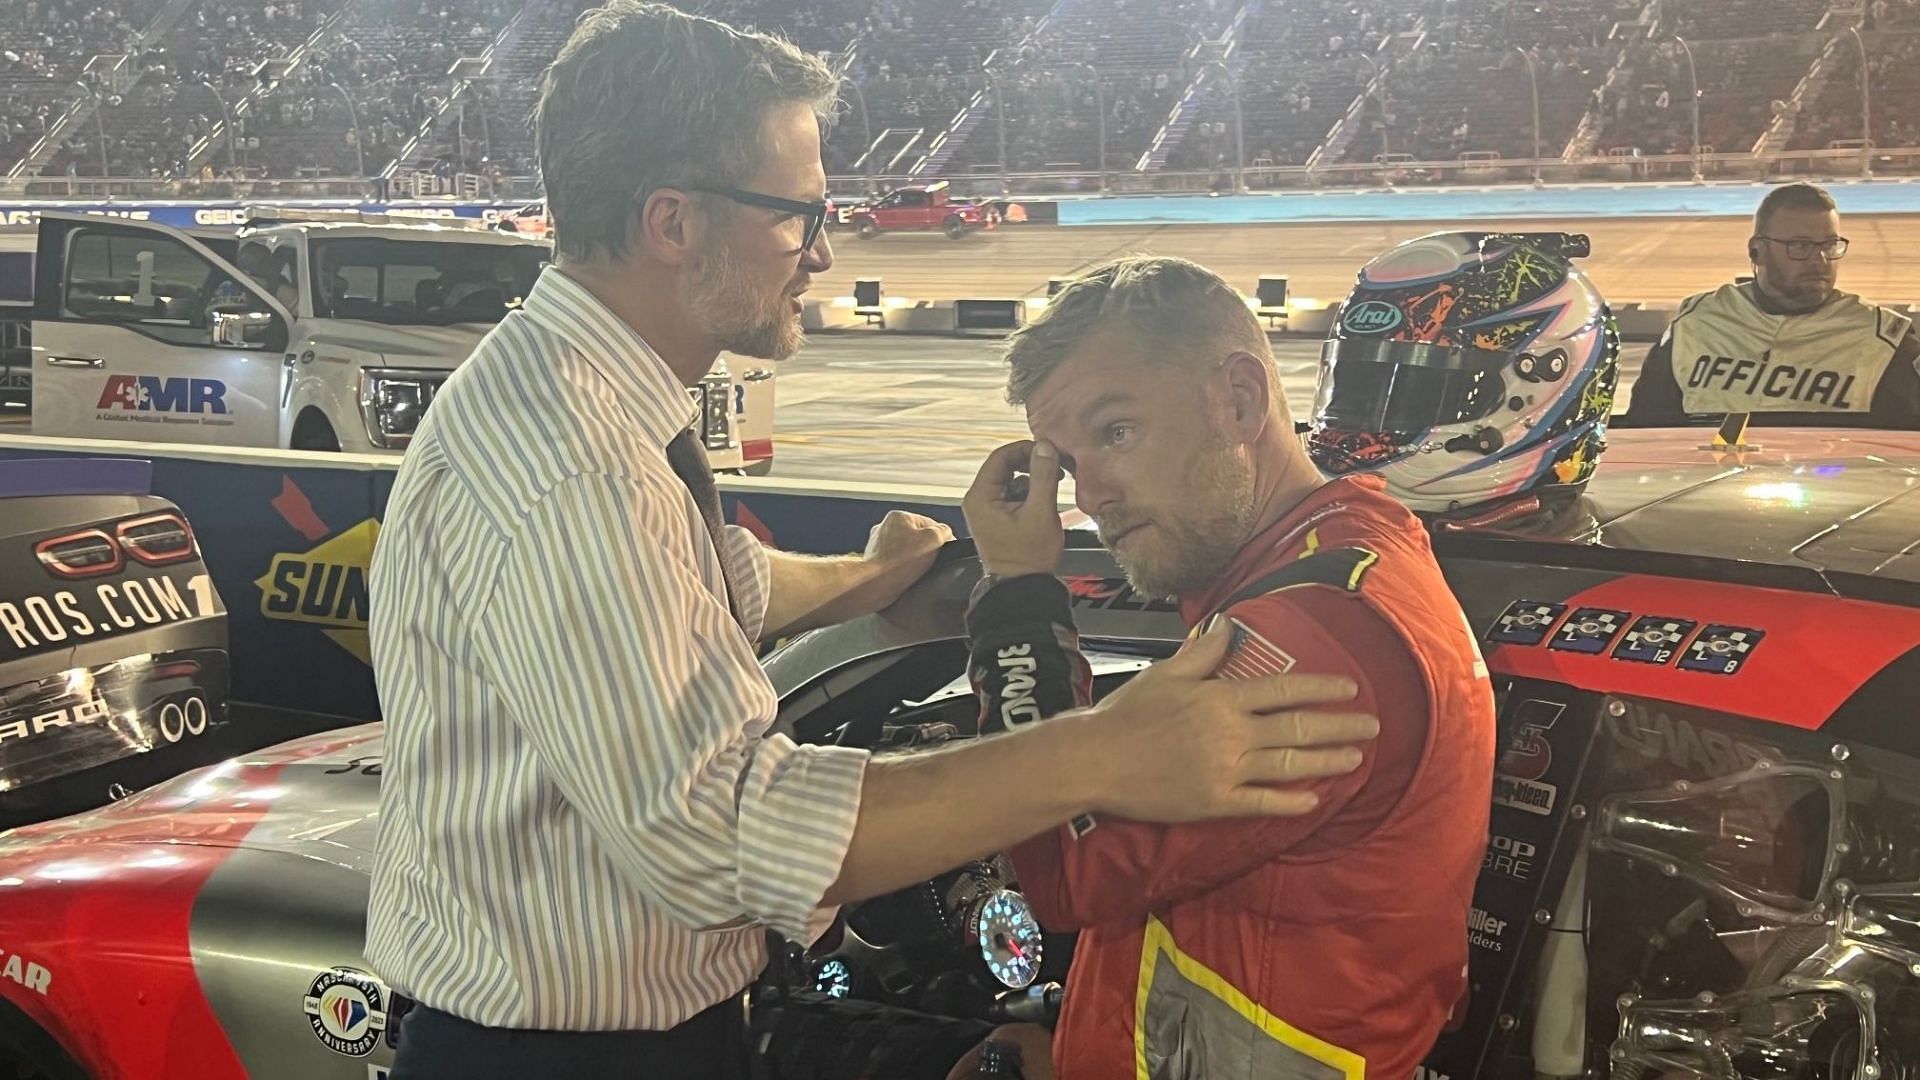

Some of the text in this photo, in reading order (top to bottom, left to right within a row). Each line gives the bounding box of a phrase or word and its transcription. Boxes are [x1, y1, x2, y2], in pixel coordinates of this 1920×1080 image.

[1346, 304, 1395, 325] Arai
[96, 374, 228, 415] AMR
[1687, 353, 1855, 409] OFFICIAL
[267, 560, 370, 622] SUN
[0, 575, 192, 649] ROS.COM
[1652, 649, 1671, 662] 12
[1723, 660, 1738, 673] 8
[997, 643, 1041, 732] BRAND
[0, 699, 110, 743] ARO
[1492, 836, 1536, 858] op
[1467, 908, 1508, 936] iller
[1469, 931, 1502, 952] lders
[0, 949, 53, 995] AR
[313, 1018, 376, 1054] ANNIVERSARY
